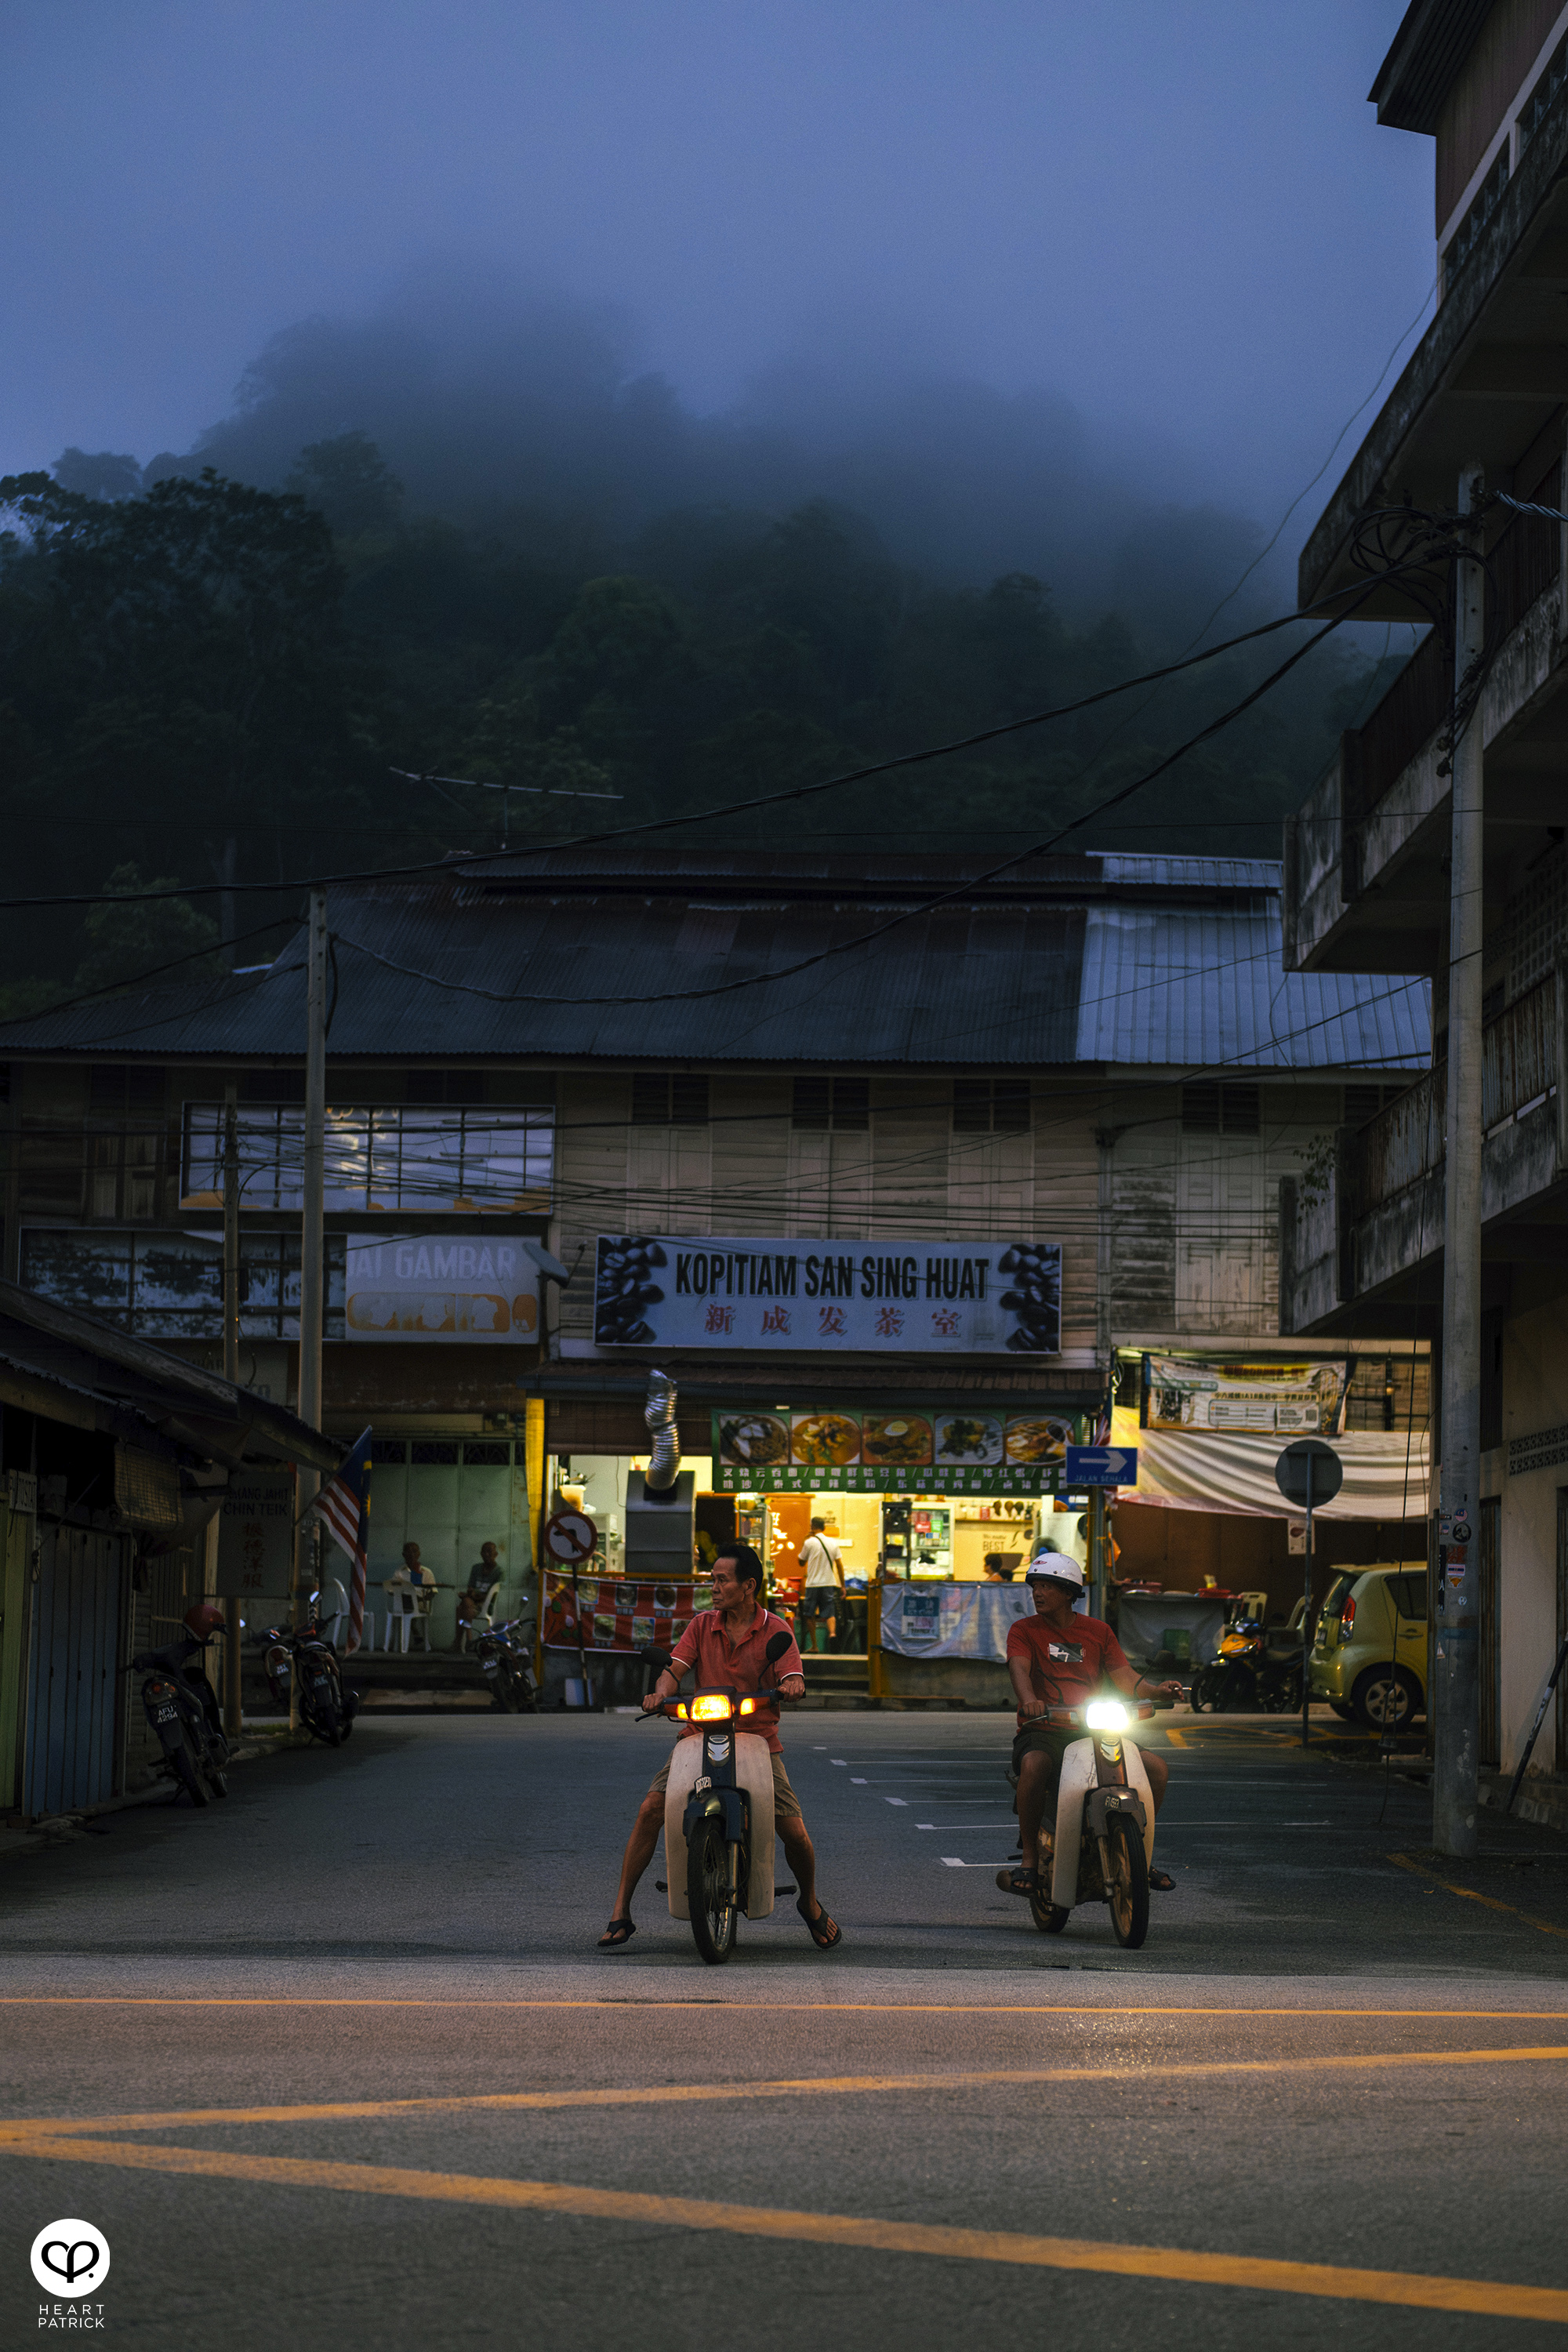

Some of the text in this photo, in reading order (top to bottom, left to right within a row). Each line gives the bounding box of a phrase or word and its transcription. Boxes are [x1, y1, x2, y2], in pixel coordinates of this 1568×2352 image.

[396, 1245, 517, 1279] GAMBAR
[676, 1253, 989, 1300] KOPITIAM SAN SING HUAT
[706, 1303, 960, 1336] 新成发茶室
[223, 1503, 288, 1515] CHIN TEIK
[264, 1487, 288, 1500] JAHIT
